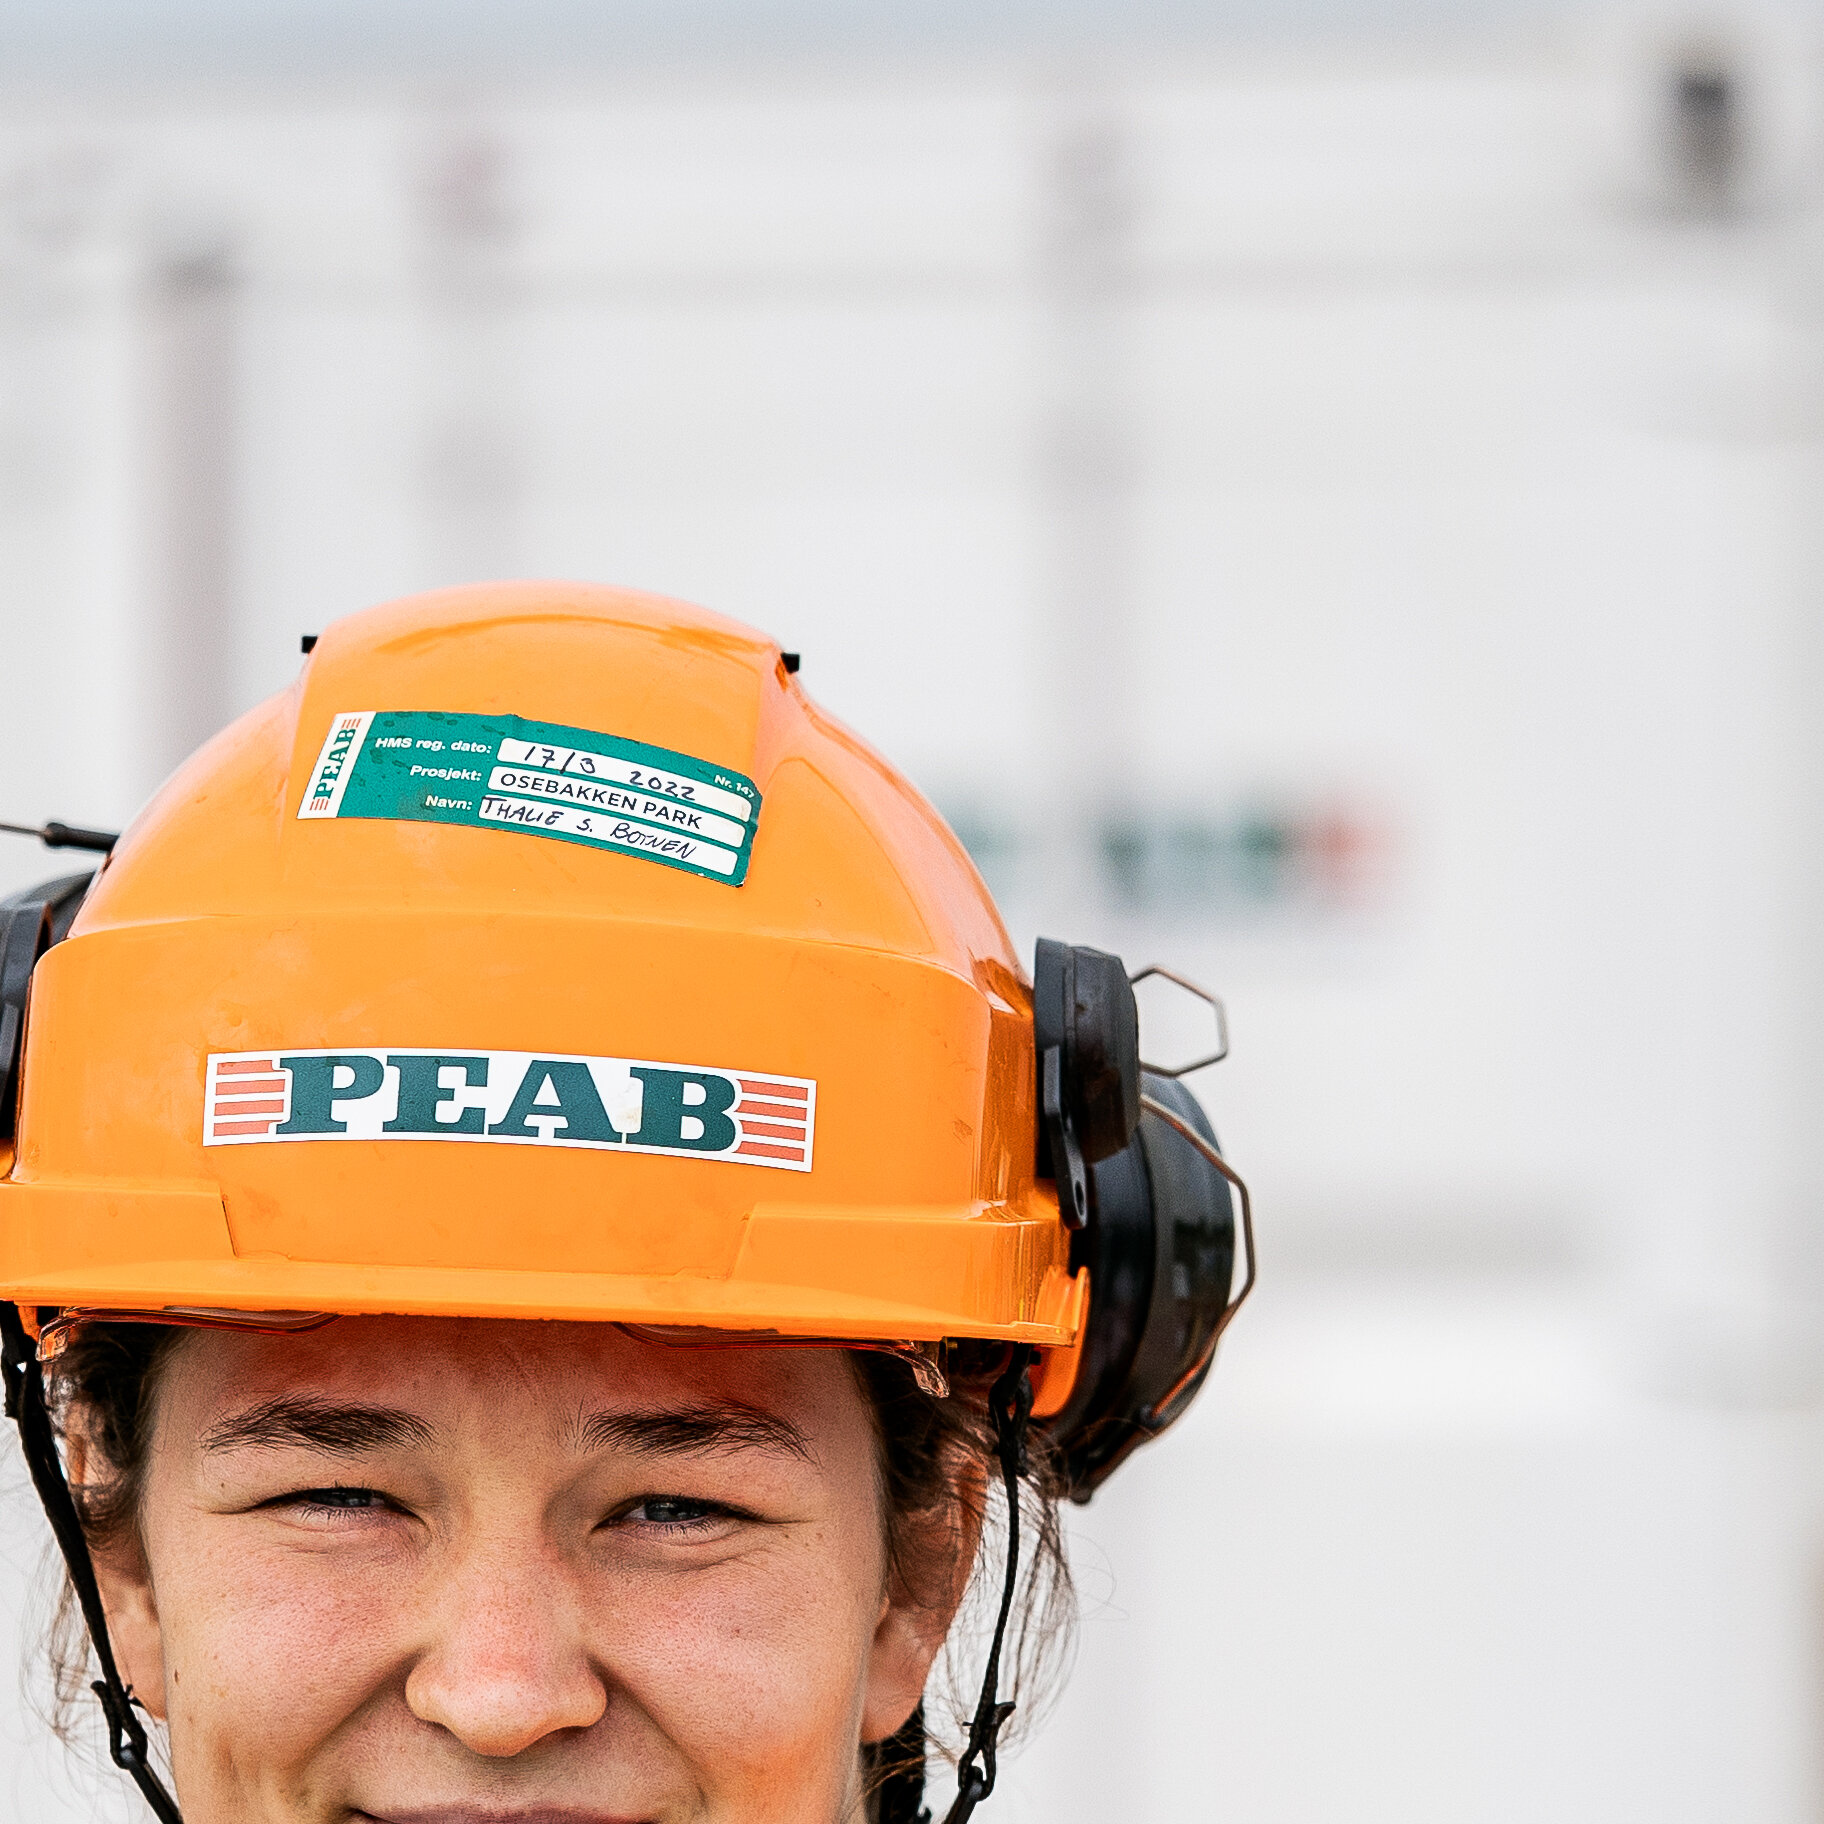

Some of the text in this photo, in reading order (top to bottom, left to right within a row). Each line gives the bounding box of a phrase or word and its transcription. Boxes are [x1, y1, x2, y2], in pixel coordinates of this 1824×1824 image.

[312, 728, 357, 800] PEAB
[375, 737, 492, 754] HMS reg. dato:
[409, 764, 483, 782] Prosjekt:
[524, 745, 696, 801] 17/3 2022
[714, 774, 733, 789] Nr.
[425, 794, 474, 811] Navn:
[500, 773, 703, 830] OSEBAKKEN PARK
[275, 1054, 738, 1153] PEAB
